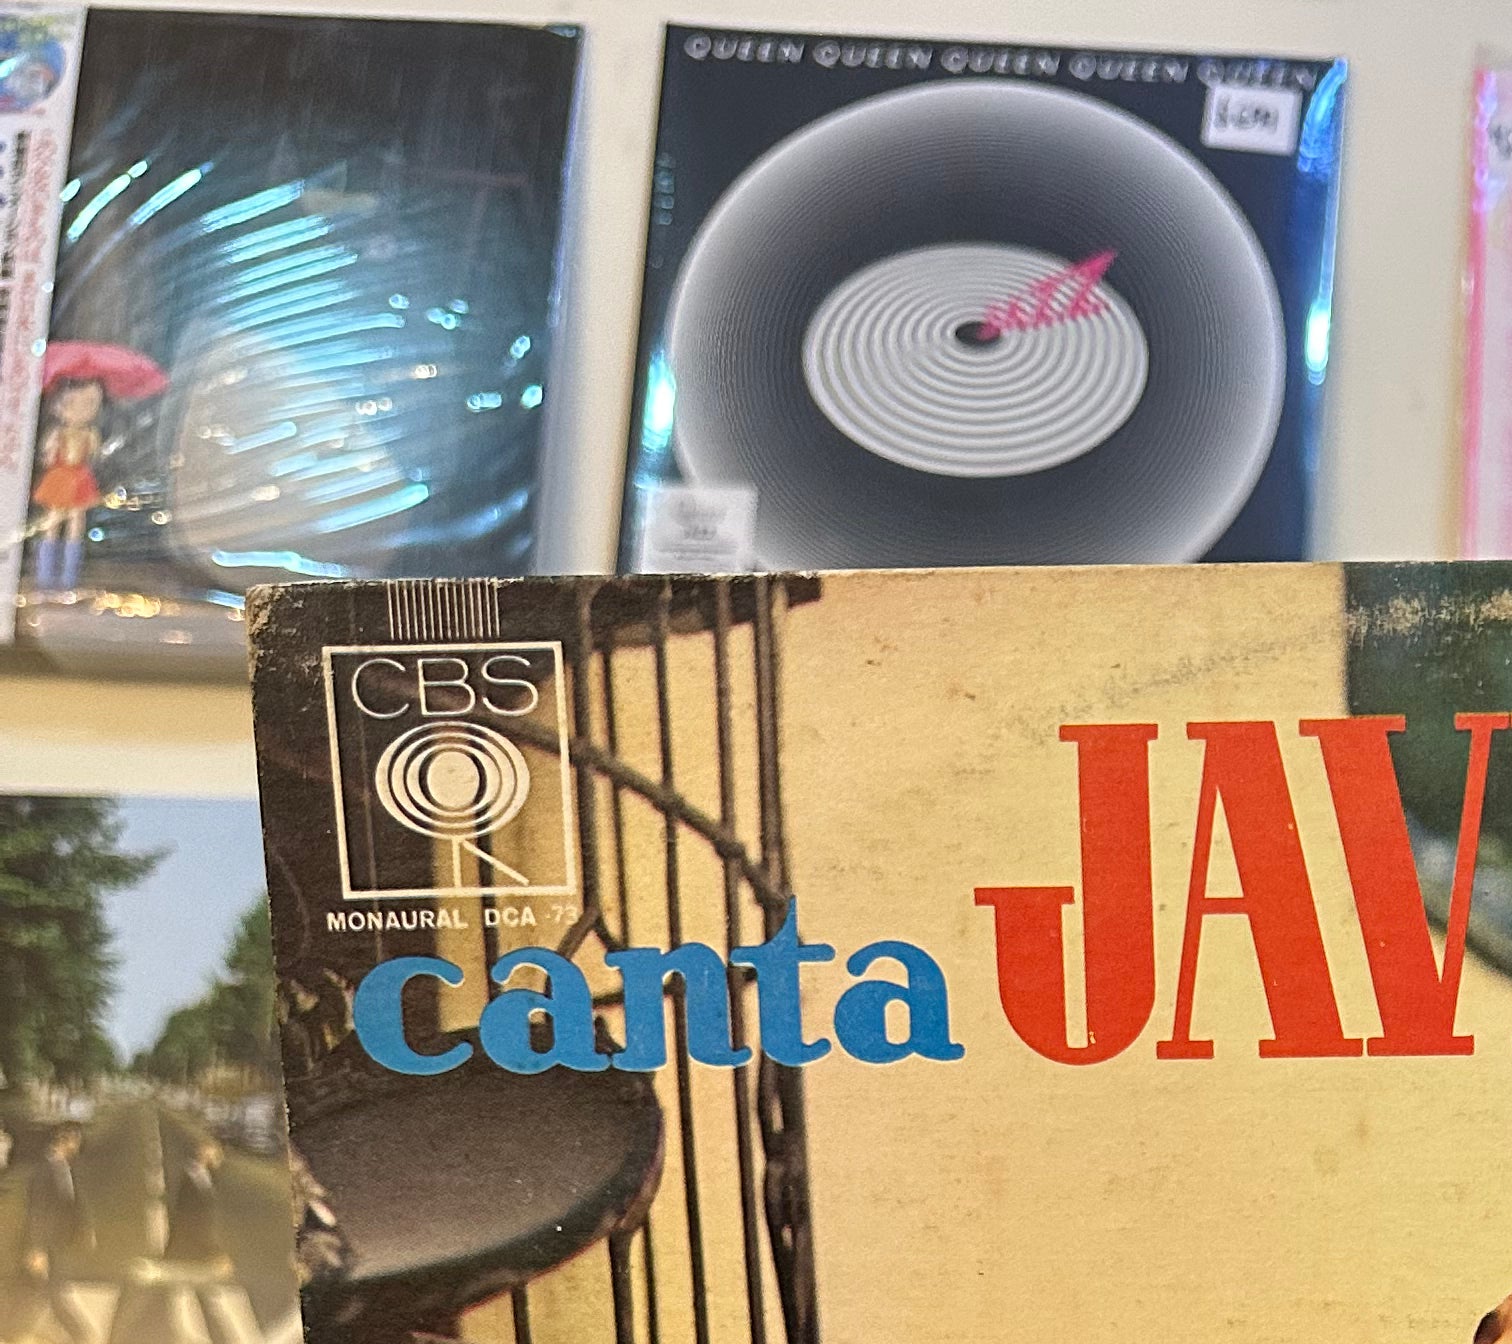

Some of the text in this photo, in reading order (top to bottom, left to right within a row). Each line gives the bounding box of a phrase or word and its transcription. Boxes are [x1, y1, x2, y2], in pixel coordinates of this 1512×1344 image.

[351, 655, 540, 720] CBS
[326, 907, 469, 933] MONAURAL
[484, 905, 538, 928] DCA
[352, 894, 966, 1077] canta
